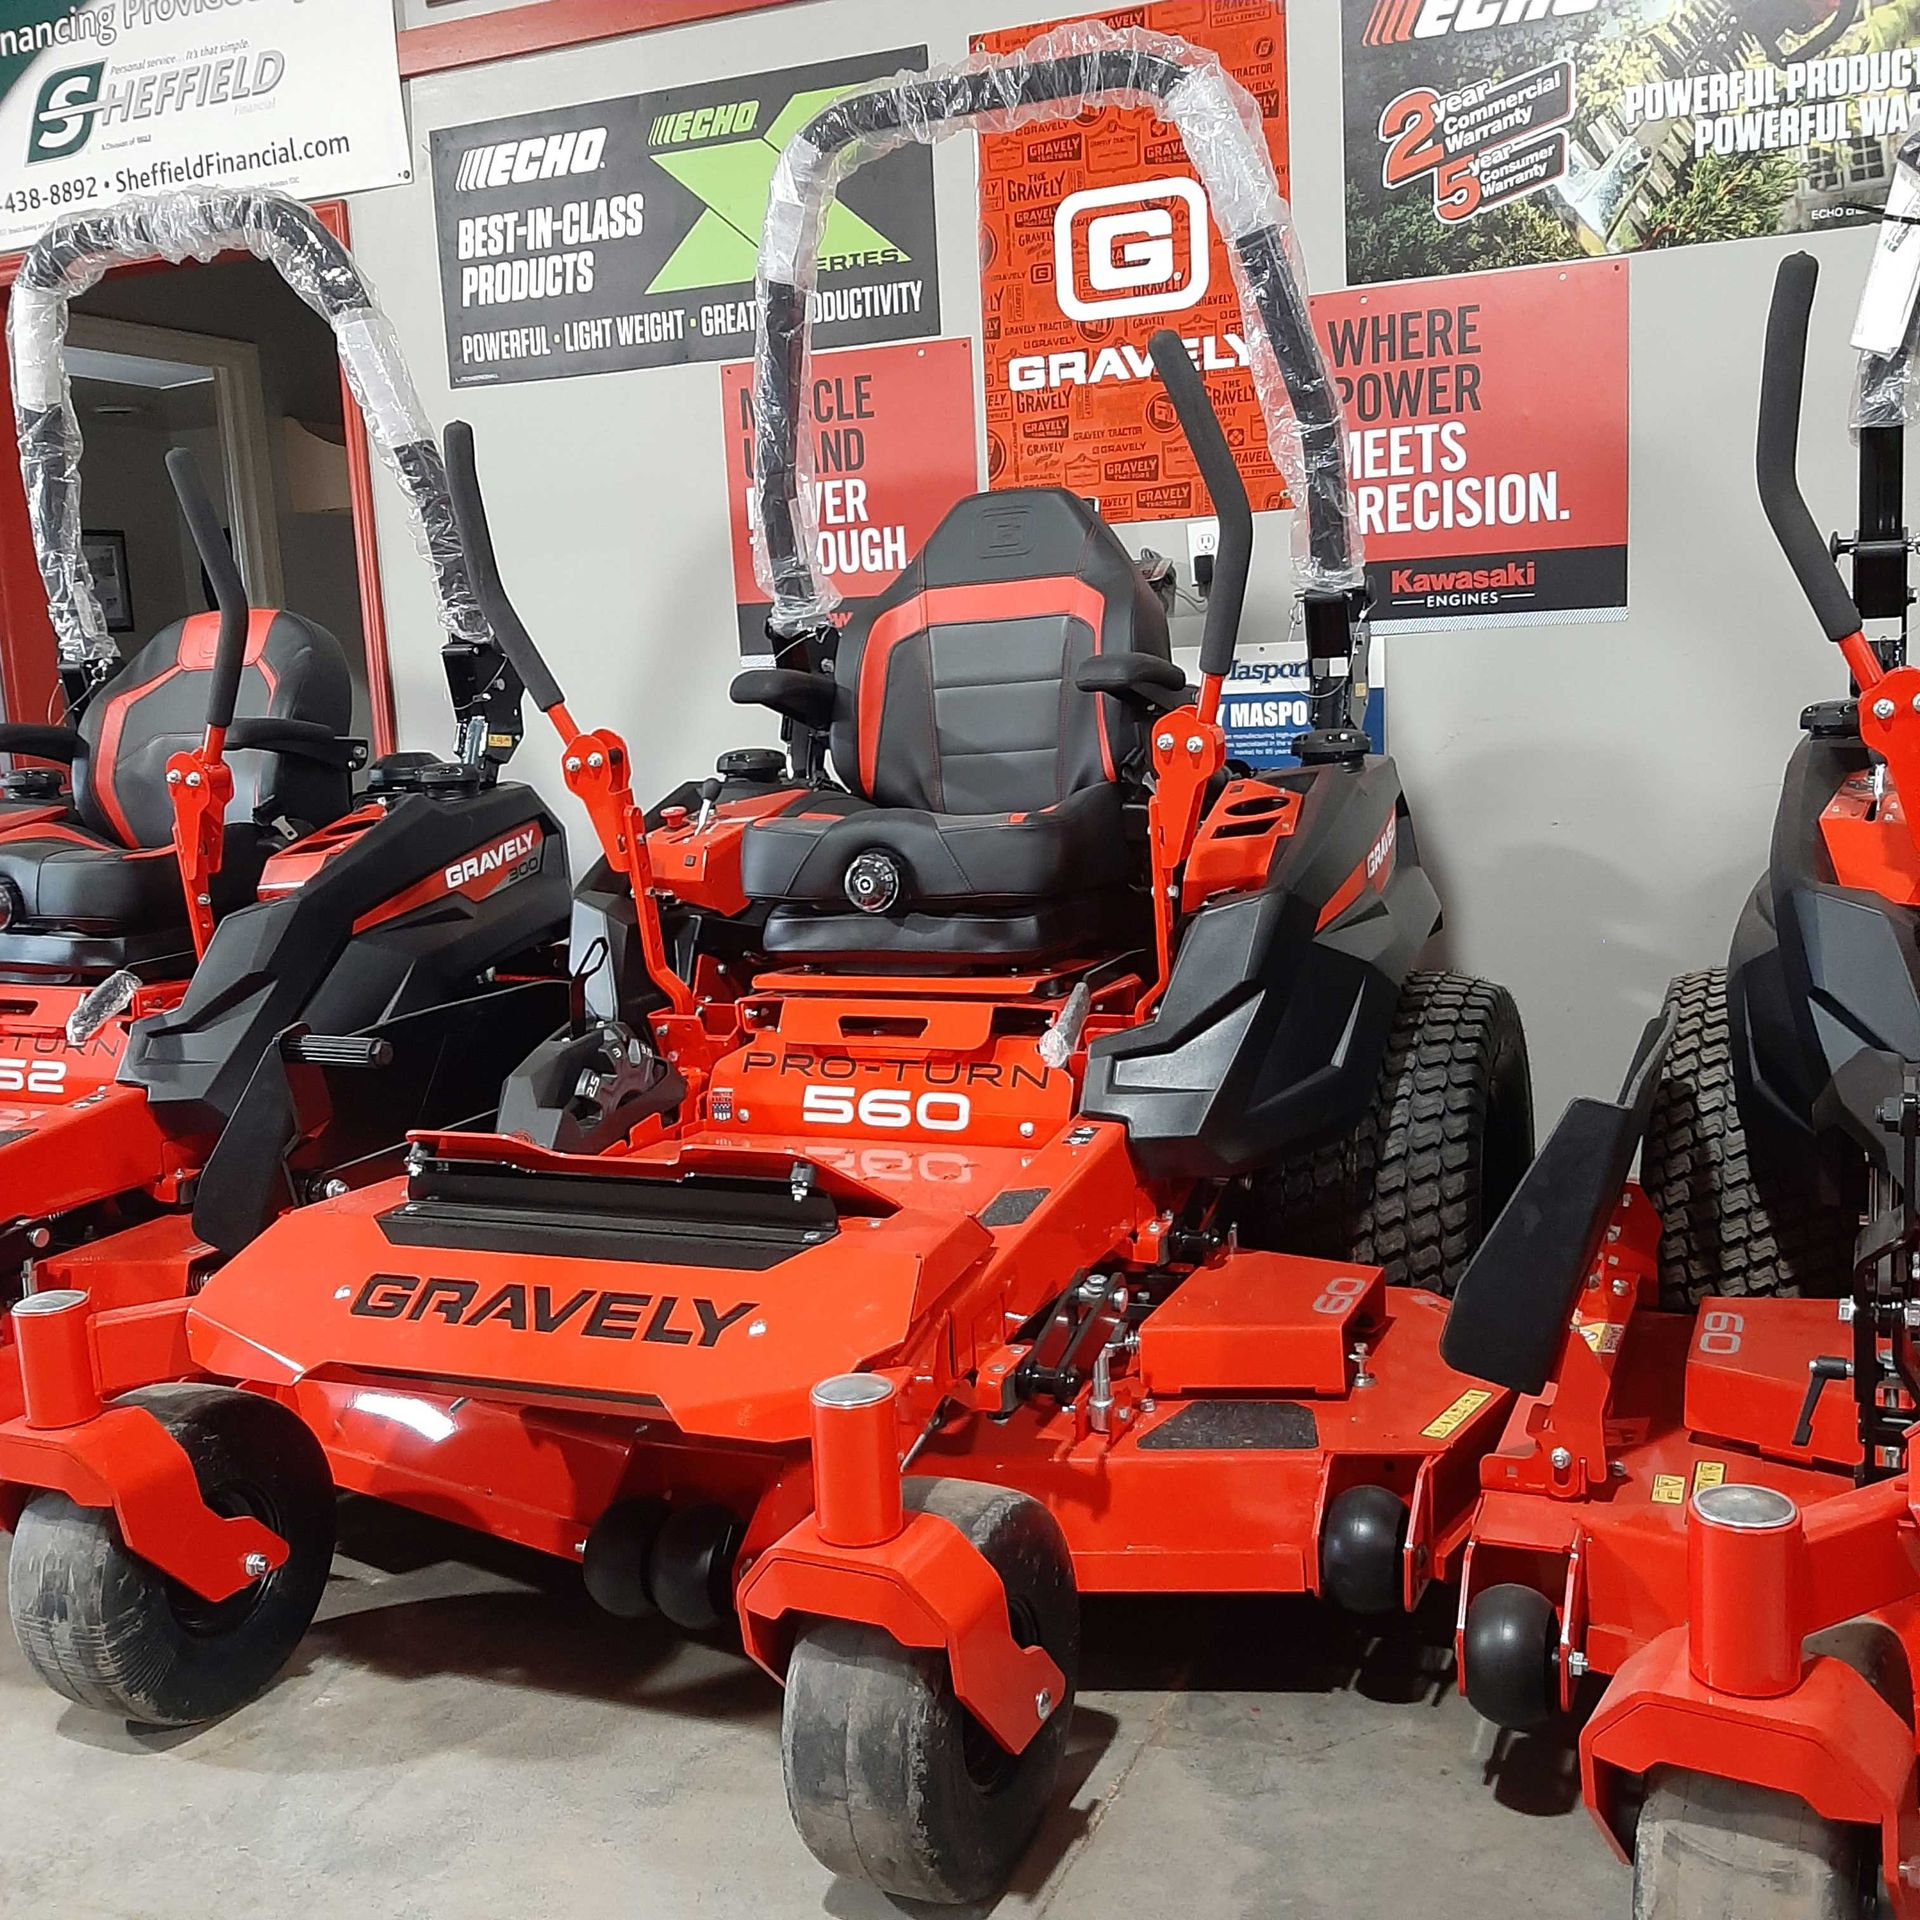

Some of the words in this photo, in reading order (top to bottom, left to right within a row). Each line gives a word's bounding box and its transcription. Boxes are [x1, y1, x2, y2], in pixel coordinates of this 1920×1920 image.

[200, 45, 219, 57] that
[1231, 62, 1273, 78] TRACTOR
[38, 50, 285, 149] SHEFFIELD
[1243, 80, 1275, 93] AVELY
[1442, 70, 1562, 135] Commercial
[1625, 65, 1780, 125] POWERFUL
[671, 100, 760, 143] ECHO
[1383, 91, 1445, 184] 2
[1429, 81, 1492, 124] year
[1444, 104, 1533, 155] Warranty
[1695, 103, 1853, 158] POWERFUL
[116, 134, 350, 193] SheffieldFinancial.com
[486, 127, 607, 188] ECHO
[1029, 136, 1081, 157] GRAVELY
[1146, 141, 1185, 158] GRAV
[1479, 144, 1556, 185] Consumer
[1007, 170, 1066, 203] GRAVELY
[1437, 153, 1481, 221] 5
[1467, 145, 1514, 178] year
[1480, 161, 1548, 199] Warranty
[457, 193, 645, 261] BEST-IN-CLASS
[1016, 207, 1057, 223] GRAVEL
[1811, 207, 1843, 220] ECHO
[1018, 231, 1052, 247] GRAVEL
[461, 250, 595, 308] PRODUCTS
[816, 249, 899, 272] ERIES
[461, 325, 552, 365] POWERFUL
[563, 318, 613, 352] LIGHT
[616, 309, 685, 346] WEIGHT
[701, 300, 757, 337] GREAT
[814, 280, 923, 324] ODUCTIVITY
[1004, 324, 1036, 336] GRAVELY
[1038, 320, 1073, 332] TRACTOR
[1031, 335, 1077, 348] GRAVELY
[1327, 304, 1482, 368] WHERE
[1016, 385, 1073, 414] GRAVELY
[1024, 419, 1069, 433] GRAVELY
[1073, 428, 1105, 440] GRAVELY
[1108, 426, 1143, 438] TRACTOR
[814, 428, 865, 475] ND
[1101, 442, 1147, 454] GRAVELY
[1106, 458, 1157, 475] GRAVELY
[1235, 450, 1271, 464] RAVEL
[1102, 497, 1129, 508] AVELY
[1138, 486, 1190, 502] GRAVELY
[1350, 471, 1570, 536] RECISION.
[1391, 561, 1536, 594] Kawasaki
[1426, 591, 1498, 608] ENGINES
[1230, 700, 1308, 728] MASPO
[445, 829, 534, 889] GRAVELY
[742, 1051, 1050, 1090] PRO-TURN
[802, 1085, 971, 1132] 560
[349, 1272, 760, 1348] GRAVELY
[1312, 1277, 1366, 1315] 60
[1699, 1311, 1745, 1355] 60
